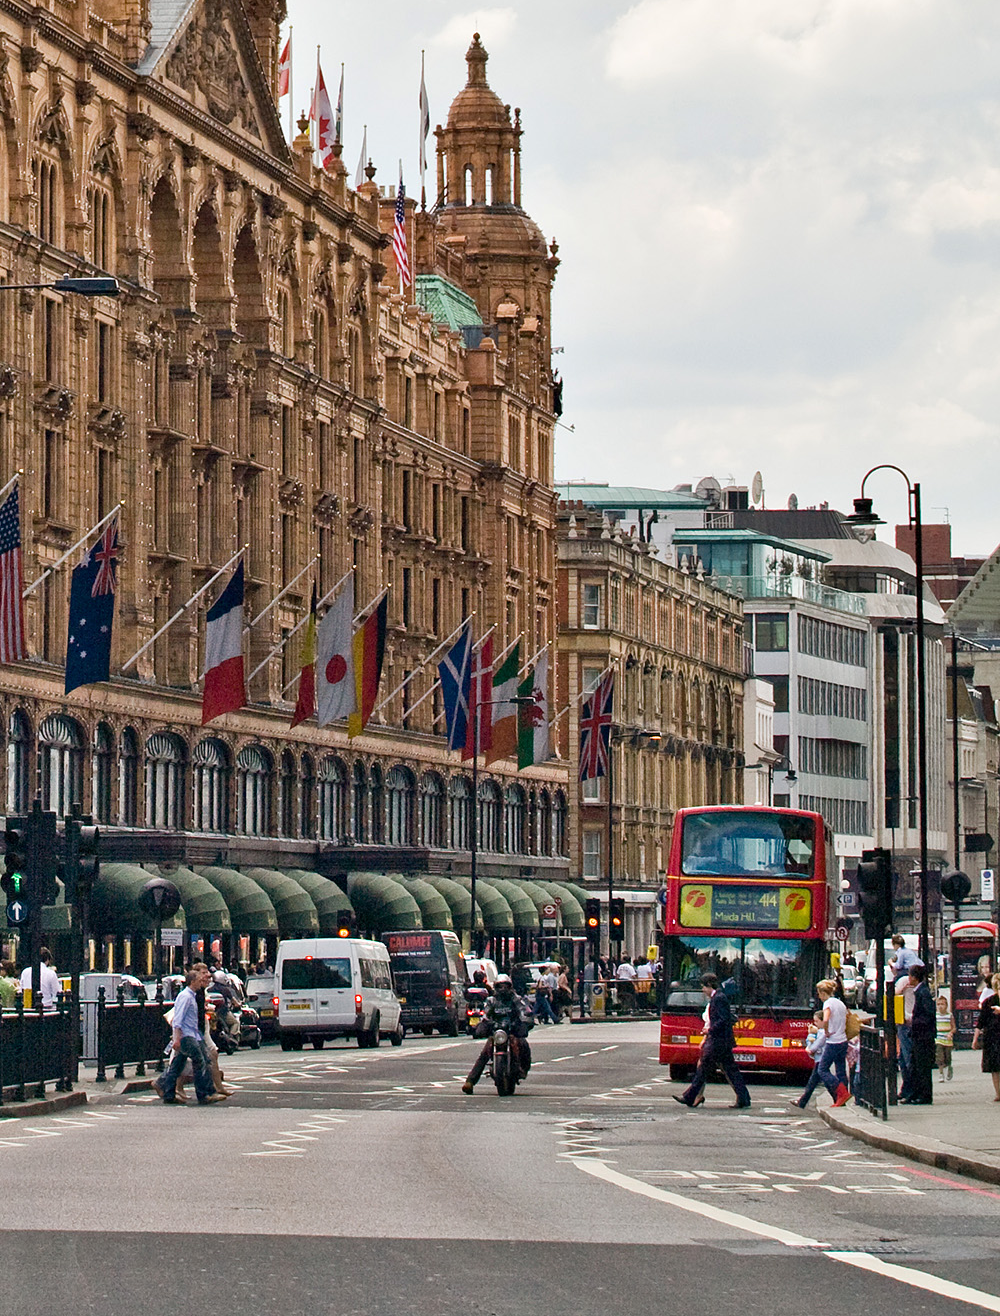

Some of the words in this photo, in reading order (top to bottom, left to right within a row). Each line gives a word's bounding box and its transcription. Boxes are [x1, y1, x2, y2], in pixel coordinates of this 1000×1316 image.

[759, 893, 778, 907] 414
[715, 912, 739, 922] Maida
[741, 912, 756, 922] Hill
[389, 936, 432, 949] CALUMET
[627, 1169, 911, 1181] LANE
[698, 1184, 926, 1195] BUS
